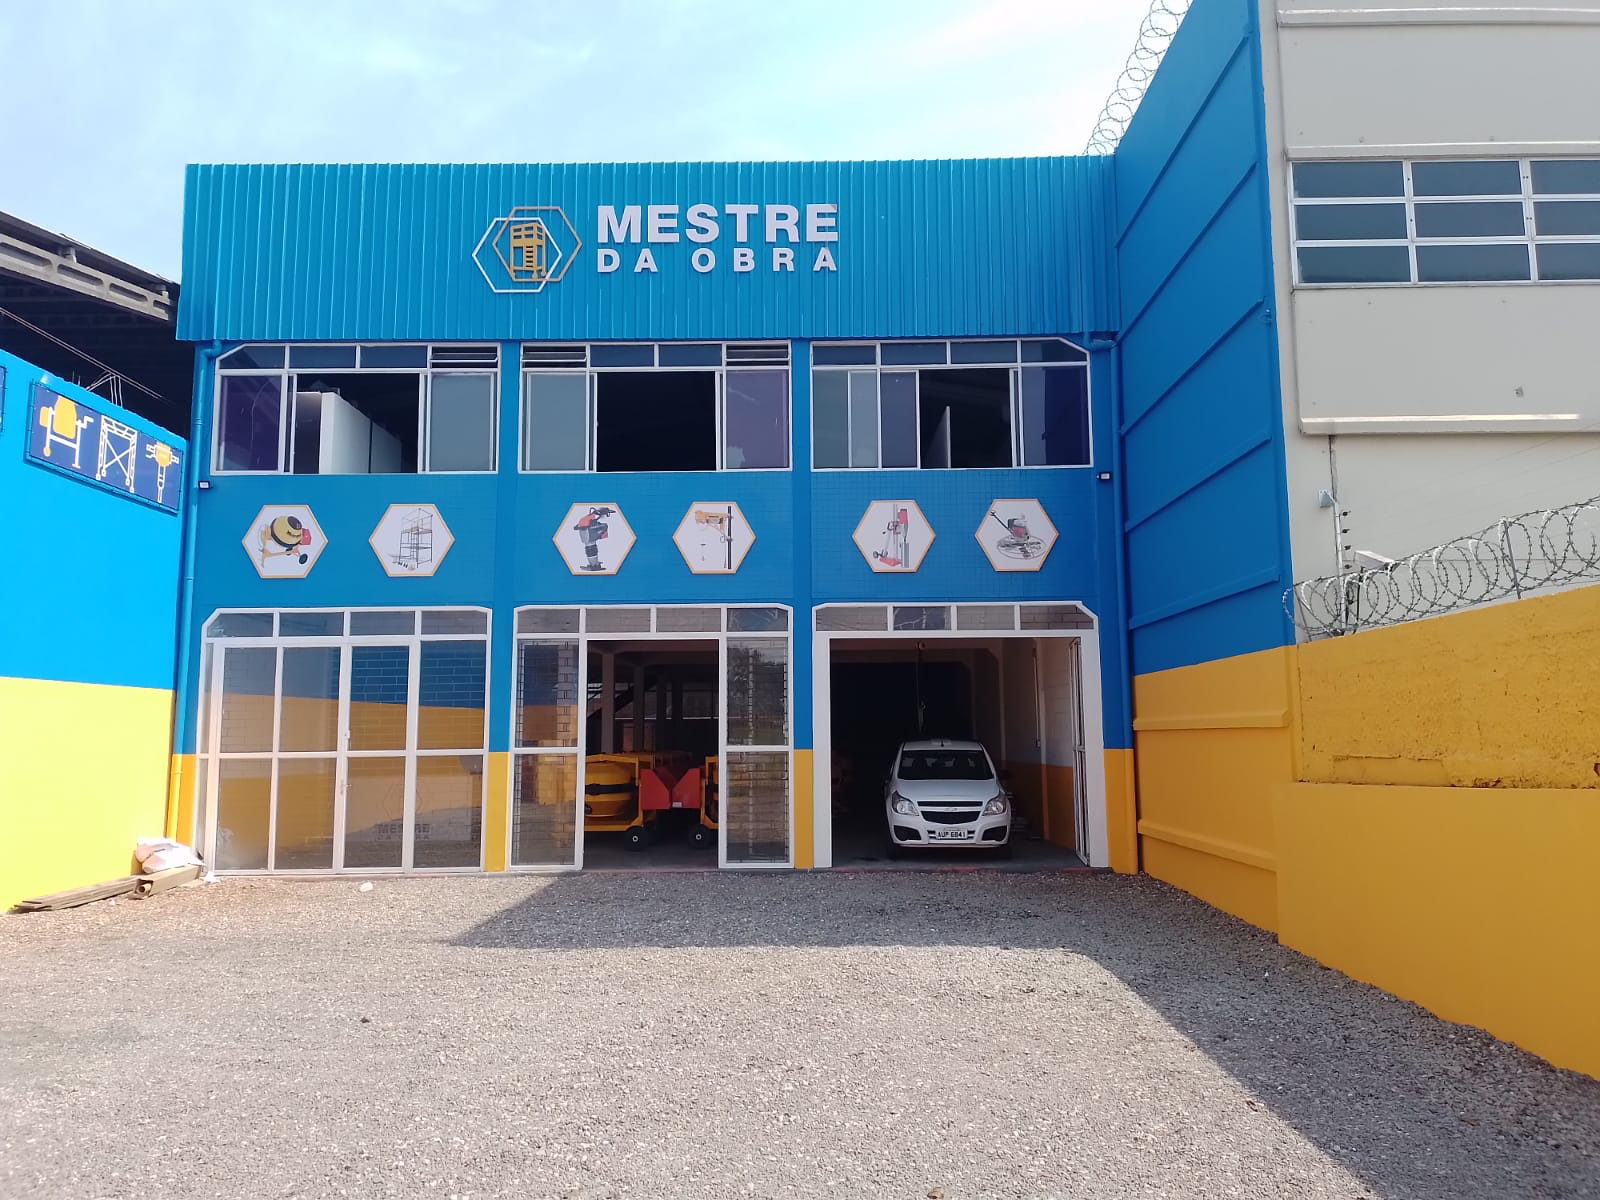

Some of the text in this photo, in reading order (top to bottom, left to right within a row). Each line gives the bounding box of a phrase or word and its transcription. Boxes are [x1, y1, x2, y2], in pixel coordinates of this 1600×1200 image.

[597, 203, 838, 243] MESTRE
[597, 247, 837, 273] DA OBRA
